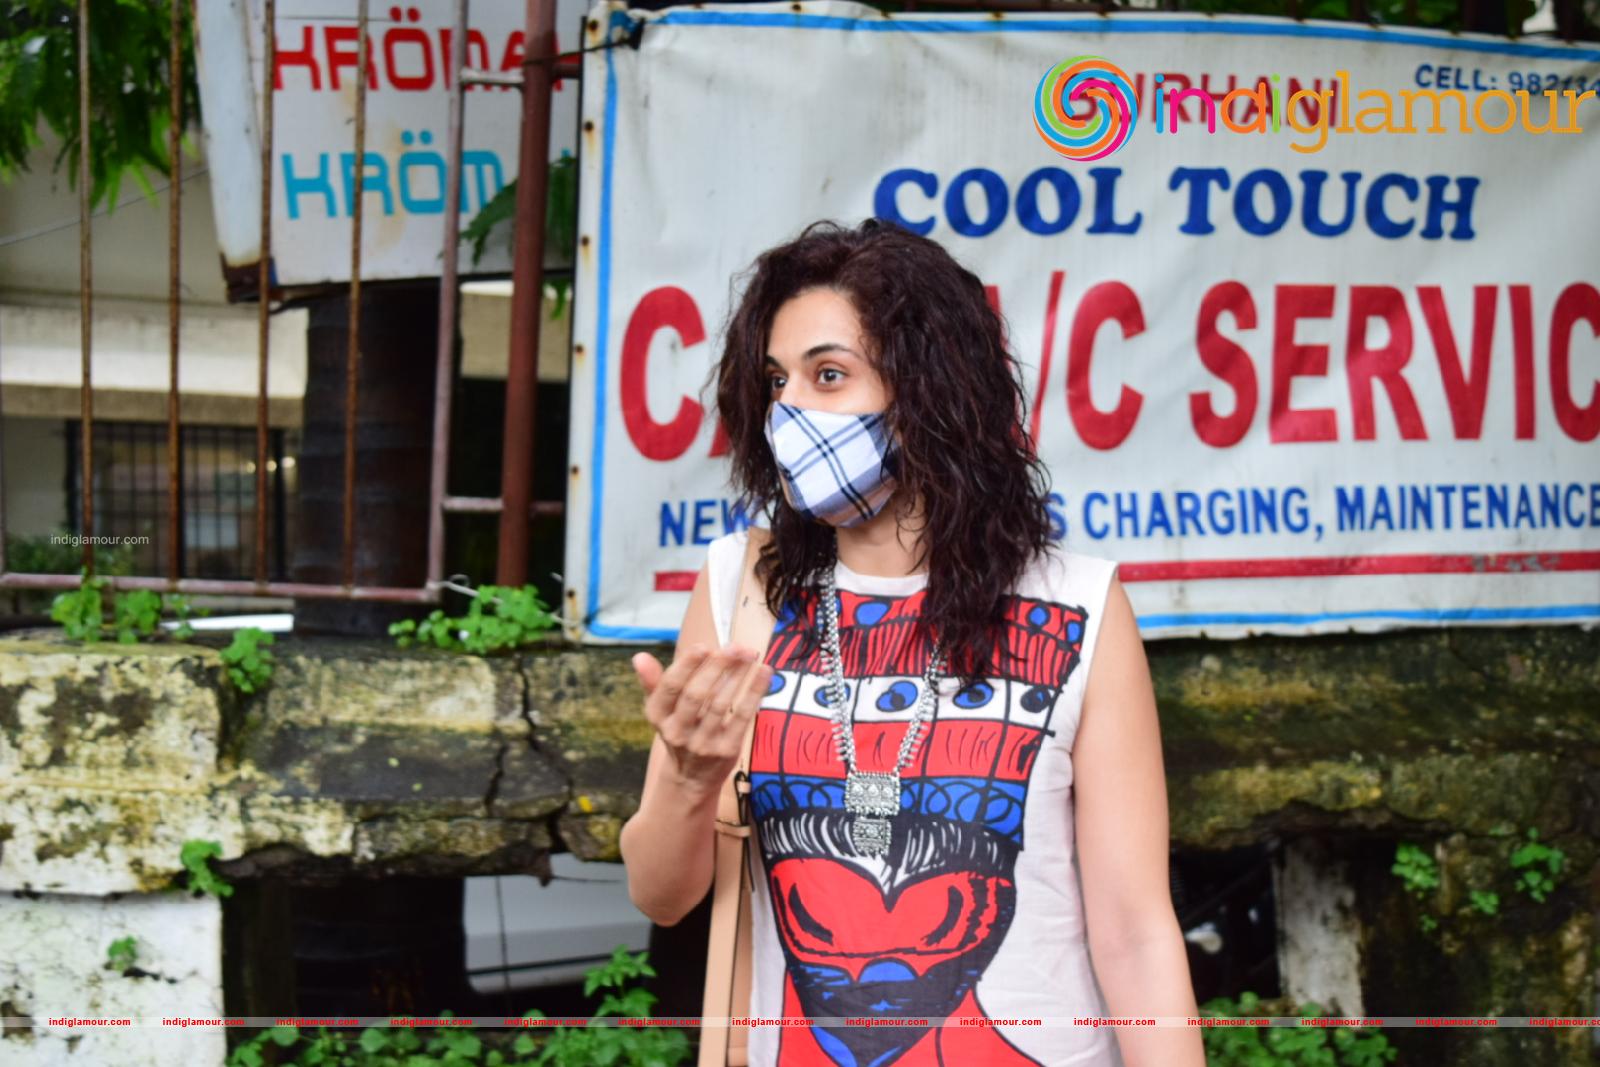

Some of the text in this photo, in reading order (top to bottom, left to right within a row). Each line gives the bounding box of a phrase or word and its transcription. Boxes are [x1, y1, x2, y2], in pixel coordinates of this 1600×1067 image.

[1415, 63, 1497, 92] CELL:
[874, 167, 1480, 240] COOL TOUCH
[1082, 486, 1324, 541] CHARGING,
